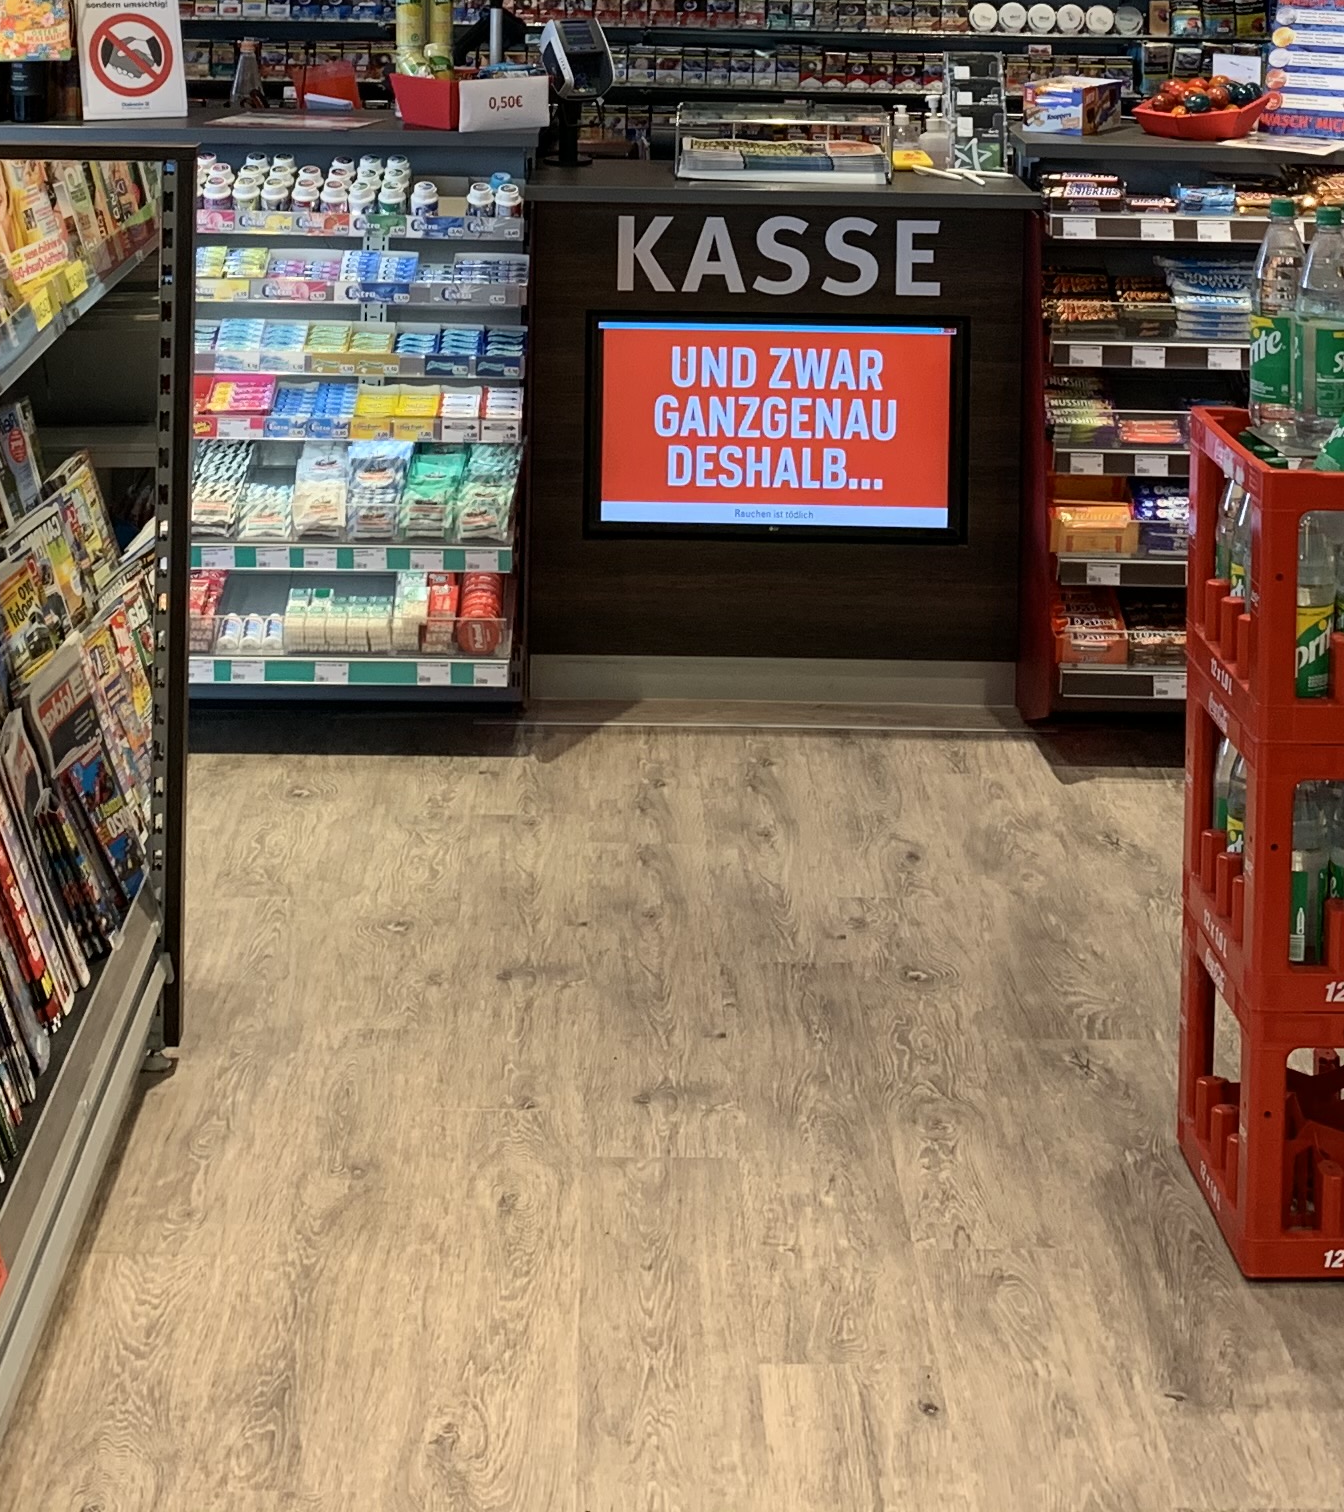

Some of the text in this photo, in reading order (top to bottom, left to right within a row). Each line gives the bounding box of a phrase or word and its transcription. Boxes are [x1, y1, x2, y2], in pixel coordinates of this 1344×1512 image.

[86, 0, 168, 10] sondern umsichtig!
[489, 96, 523, 111] 0,50€
[617, 215, 942, 297] KASSE
[671, 346, 884, 391] UND ZWAR
[654, 395, 897, 442] GANZGENAU
[667, 445, 884, 490] DESHALB...
